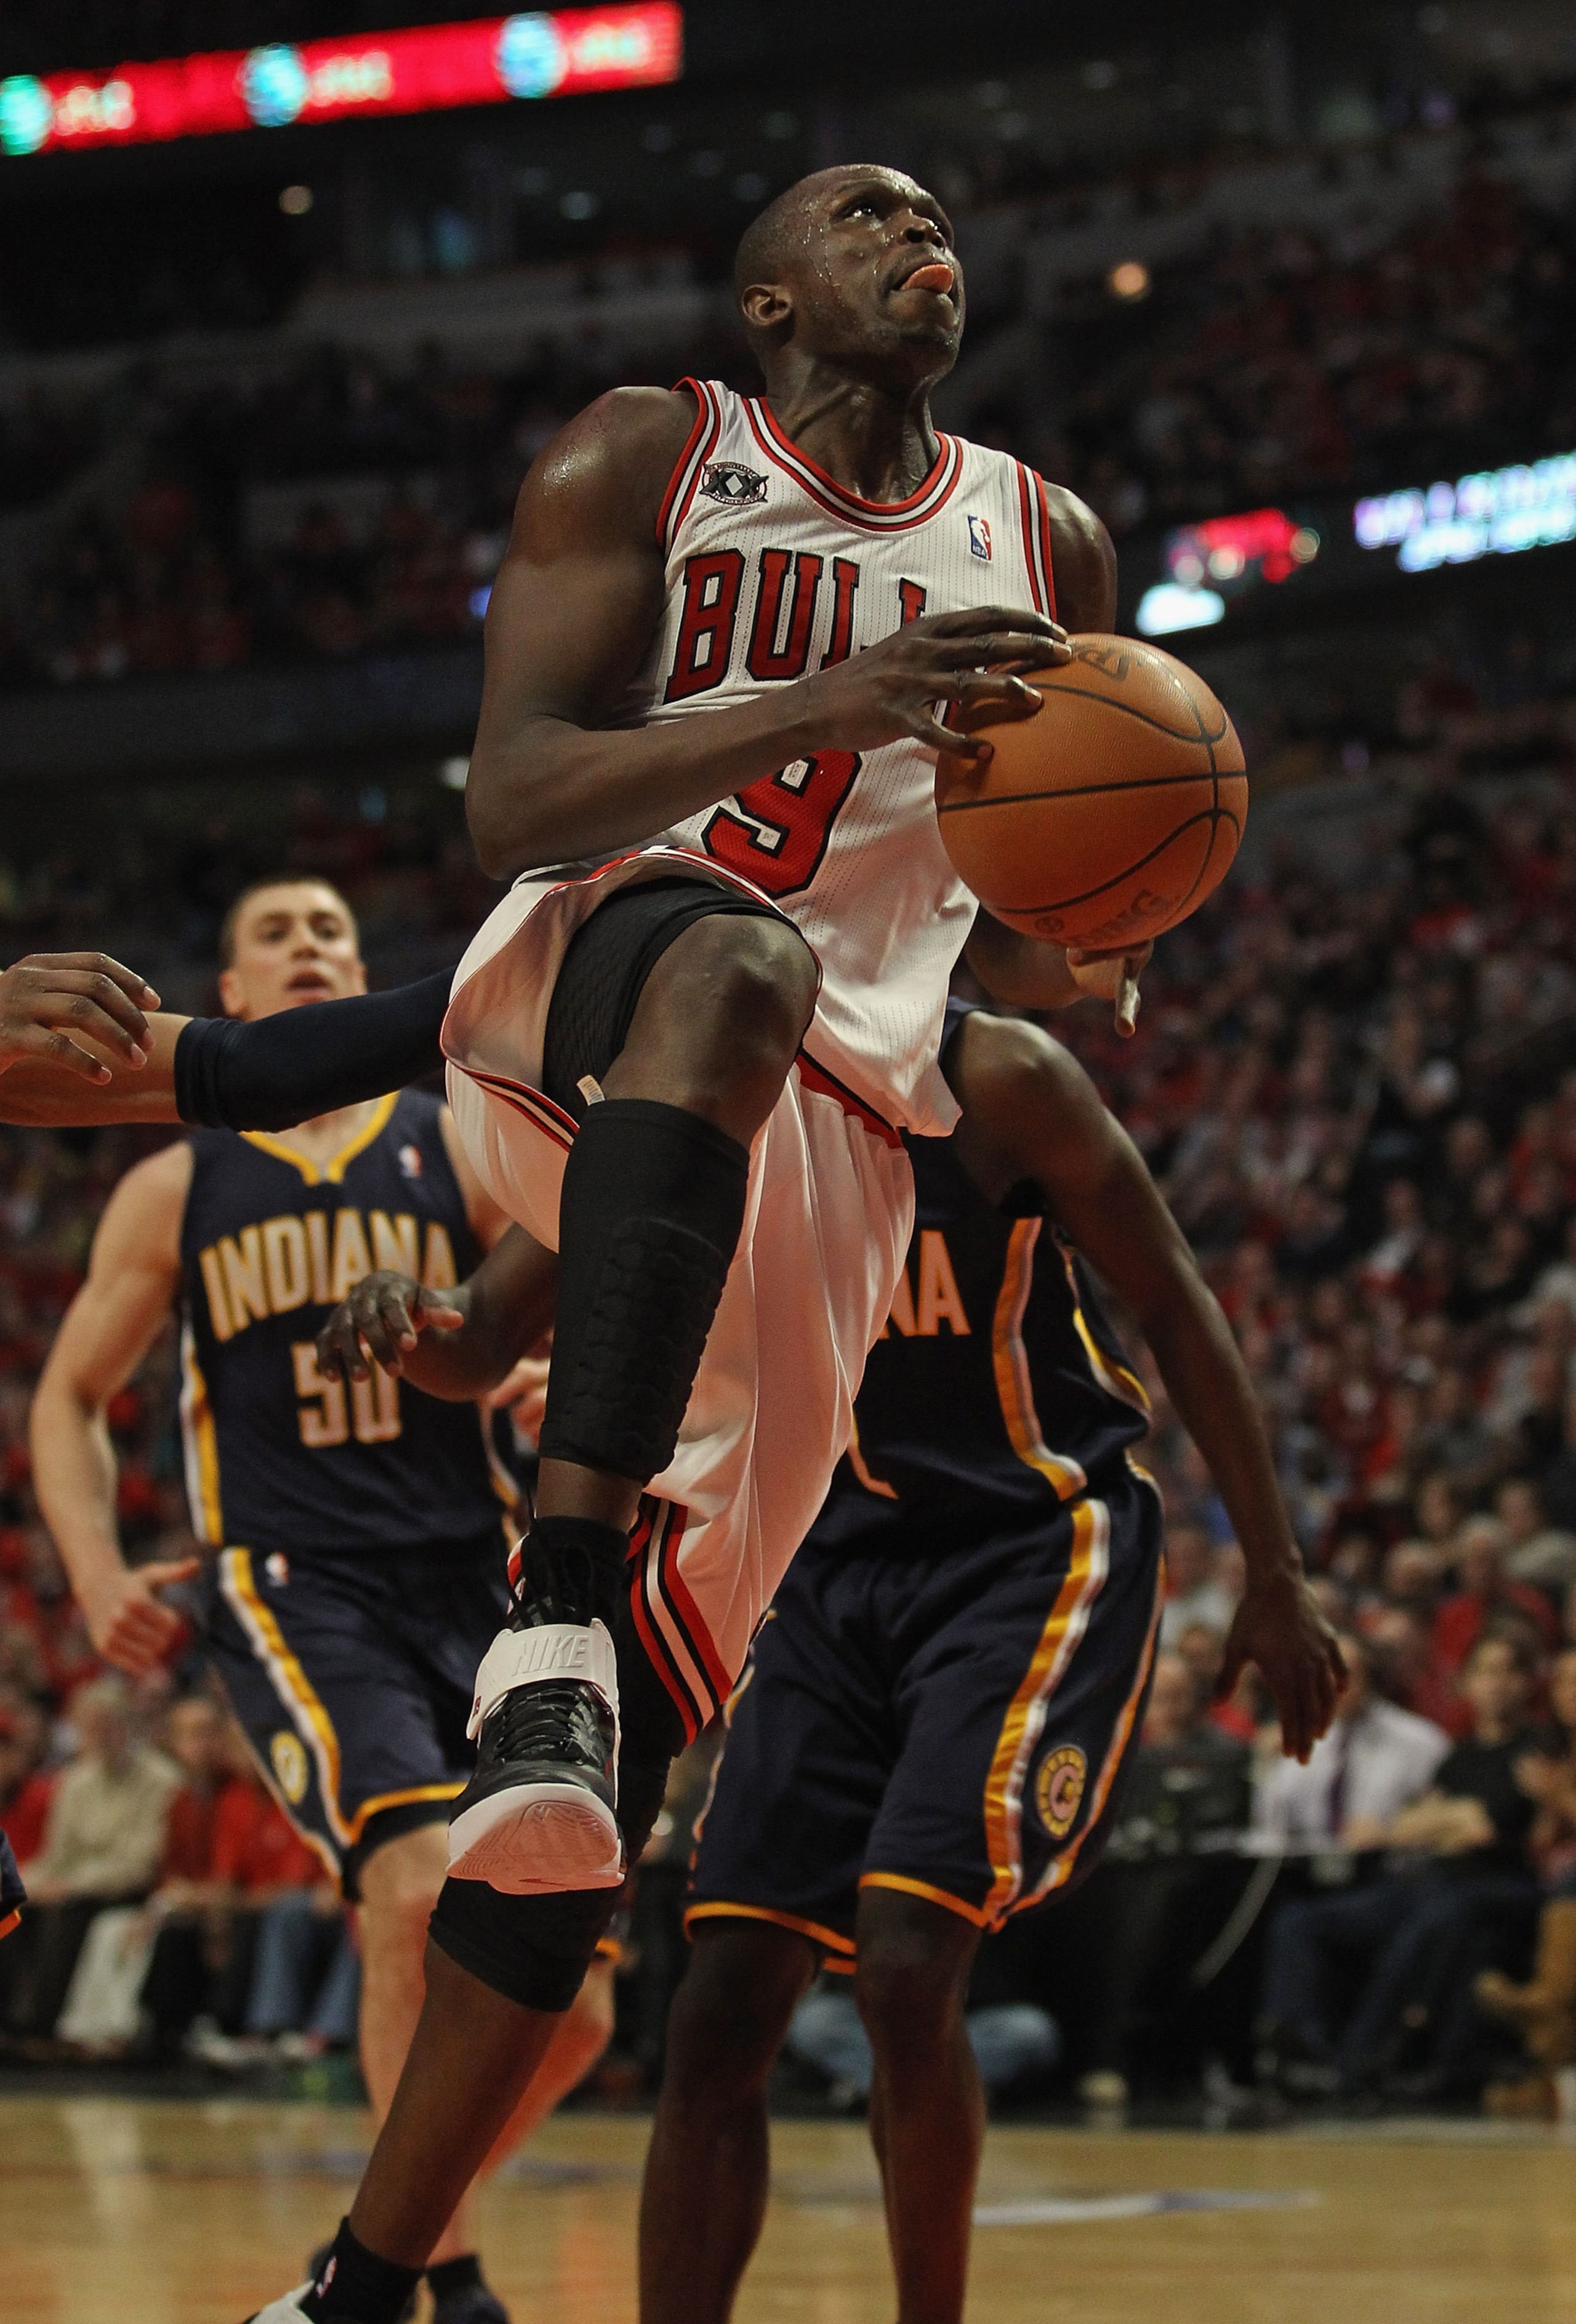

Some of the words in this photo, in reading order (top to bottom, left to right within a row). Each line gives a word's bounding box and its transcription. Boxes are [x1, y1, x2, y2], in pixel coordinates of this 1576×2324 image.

[662, 548, 927, 705] BUL
[701, 748, 862, 900] 9
[511, 1635, 589, 1677] NIKE
